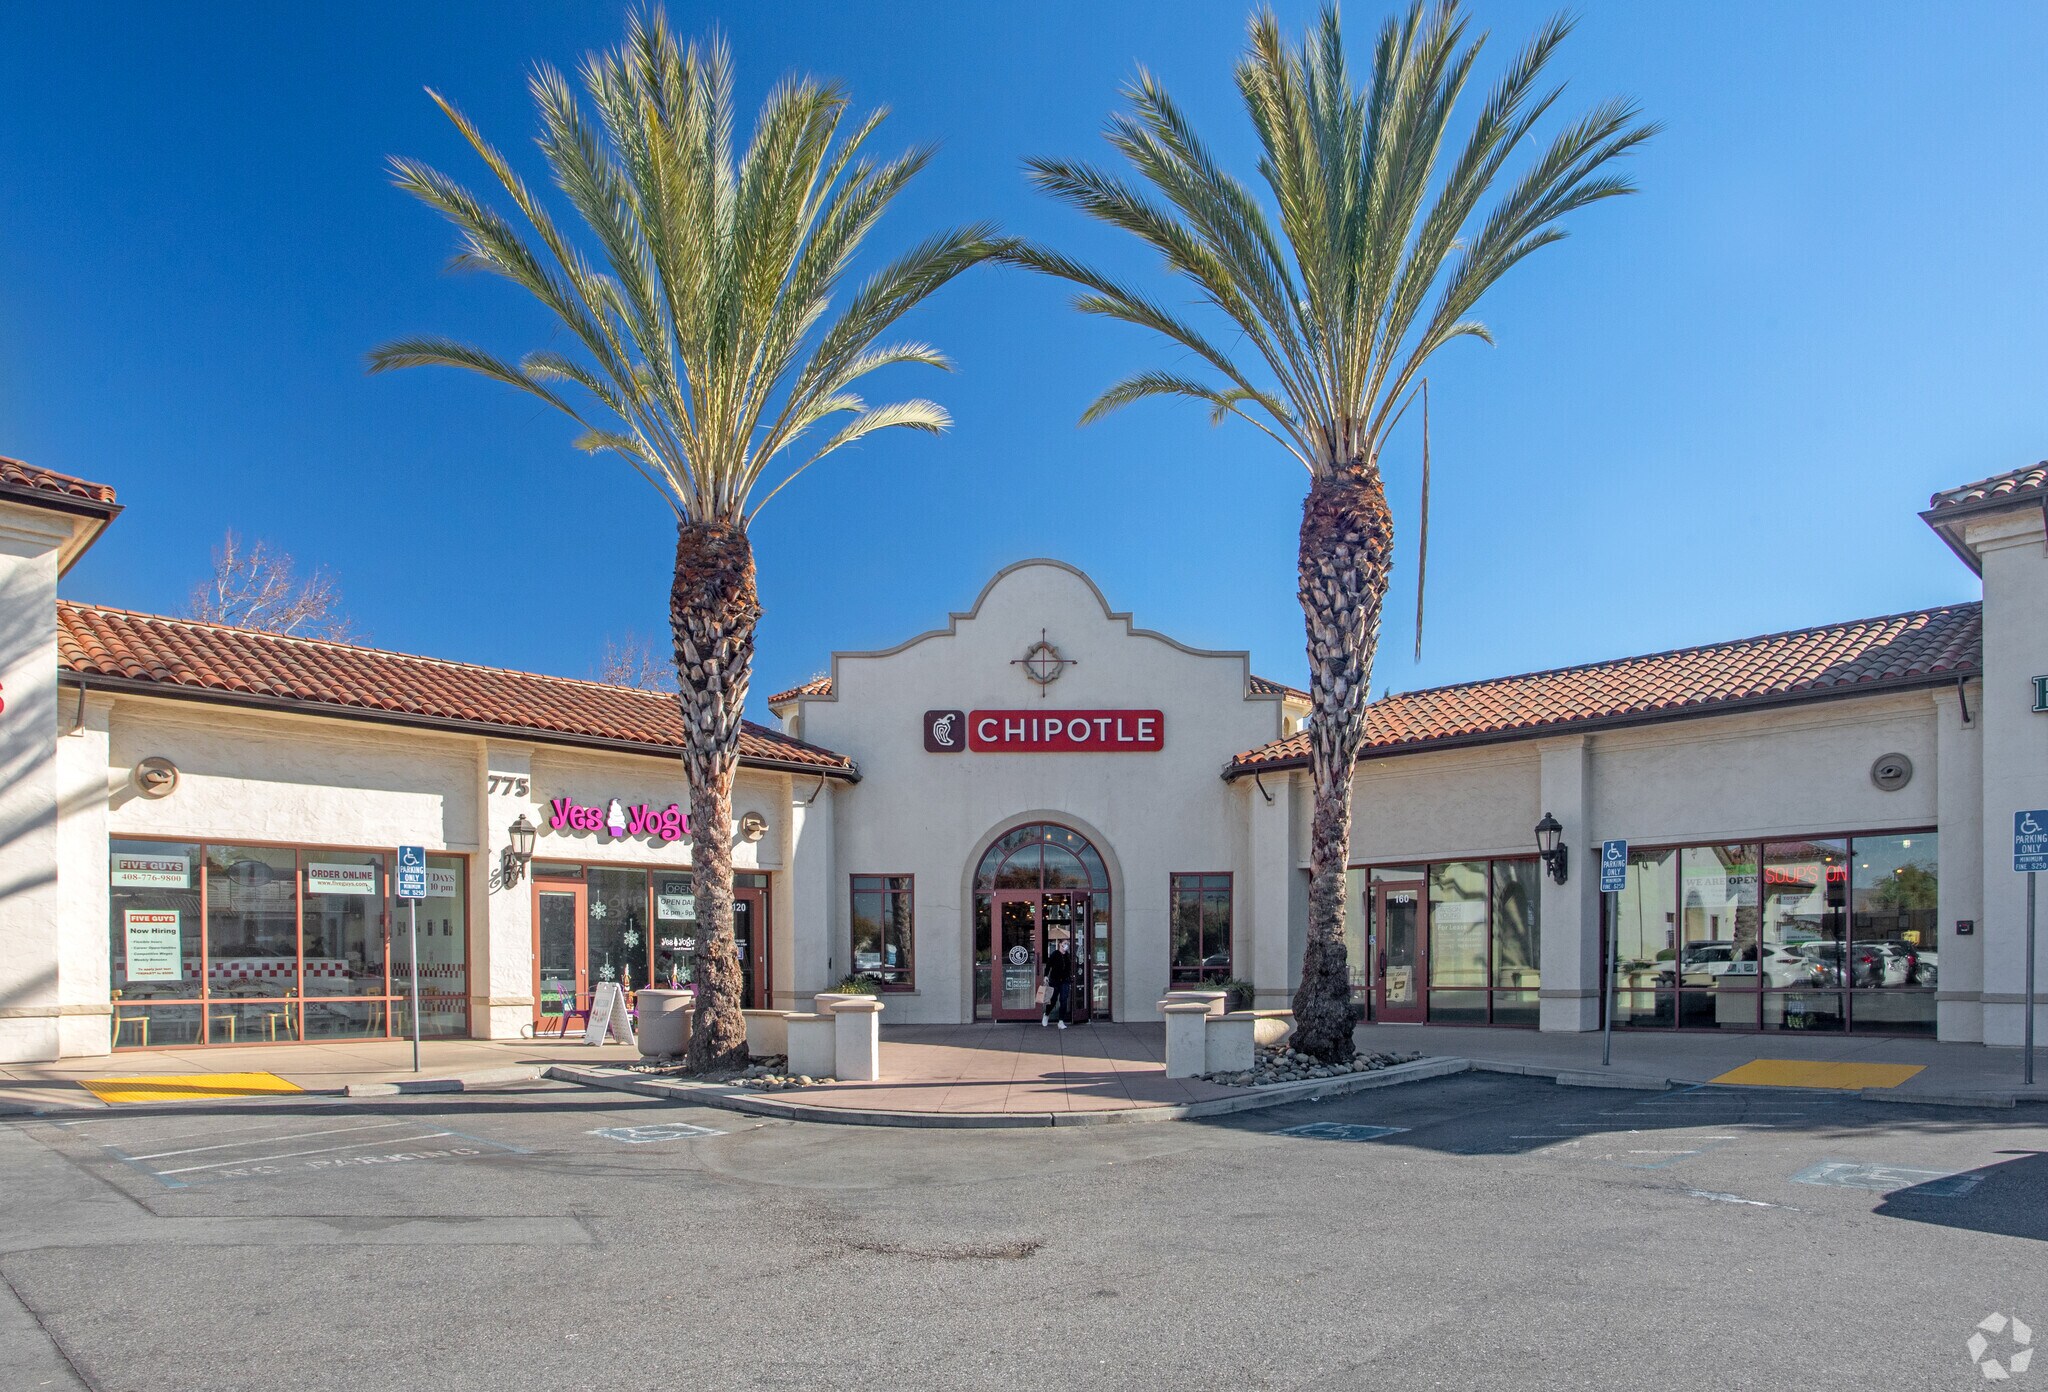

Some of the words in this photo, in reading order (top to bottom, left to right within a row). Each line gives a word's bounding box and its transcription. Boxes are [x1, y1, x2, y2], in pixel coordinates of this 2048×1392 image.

[977, 718, 1155, 742] CHIPOTLE
[488, 775, 529, 797] 775
[627, 804, 692, 841] Yogu
[2016, 834, 2048, 844] PARKING
[2021, 844, 2041, 854] ONLY
[120, 861, 147, 870] FIVE
[150, 862, 182, 871] GUYS
[1603, 860, 1625, 868] PARKING
[2031, 862, 2047, 870] $250
[311, 869, 340, 878] ORDER
[343, 871, 373, 880] ONLINE
[400, 866, 424, 874] PARKING
[1606, 868, 1621, 876] ONLY
[1765, 865, 1818, 884] SOUP'S
[1826, 863, 1848, 882] ON
[122, 873, 181, 882] 408-776-9800
[404, 874, 420, 882] ONLY
[432, 873, 455, 883] DAYS
[1704, 878, 1725, 886] ARE
[1728, 876, 1758, 885] OPEN
[430, 883, 438, 891] 10
[667, 885, 693, 894] OPEN
[661, 898, 680, 906] OPEN
[682, 898, 693, 906] DAI
[1395, 895, 1409, 904] 160
[732, 902, 746, 911] 120
[678, 937, 696, 947] Yogu
[306, 1148, 480, 1169] PARKING
